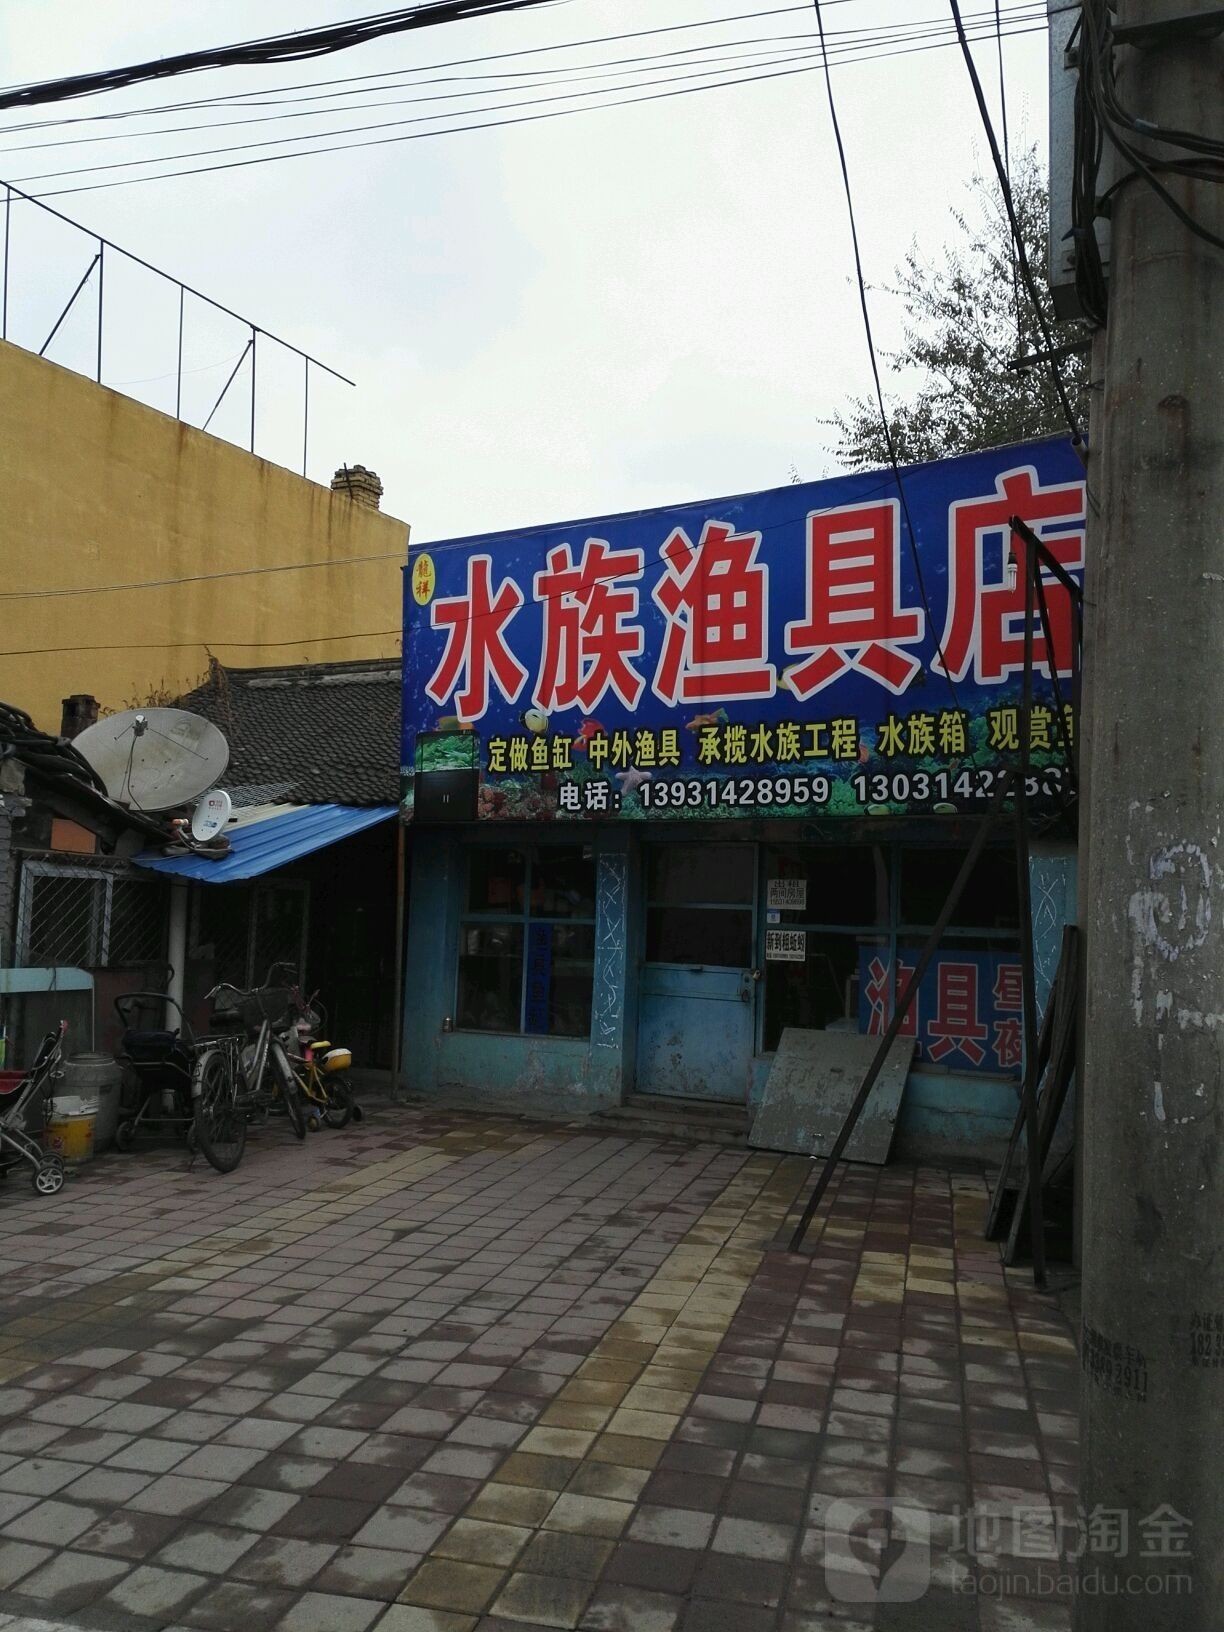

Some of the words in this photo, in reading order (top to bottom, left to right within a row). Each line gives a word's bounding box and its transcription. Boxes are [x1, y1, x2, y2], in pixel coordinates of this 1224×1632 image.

[425, 464, 1087, 723] 水族渔具店
[488, 735, 572, 772] 定做鱼缸
[589, 729, 681, 769] 中外渔具
[698, 719, 857, 764] 承揽水族工程
[879, 711, 966, 757] 水族箱
[640, 776, 829, 806] 13931428959
